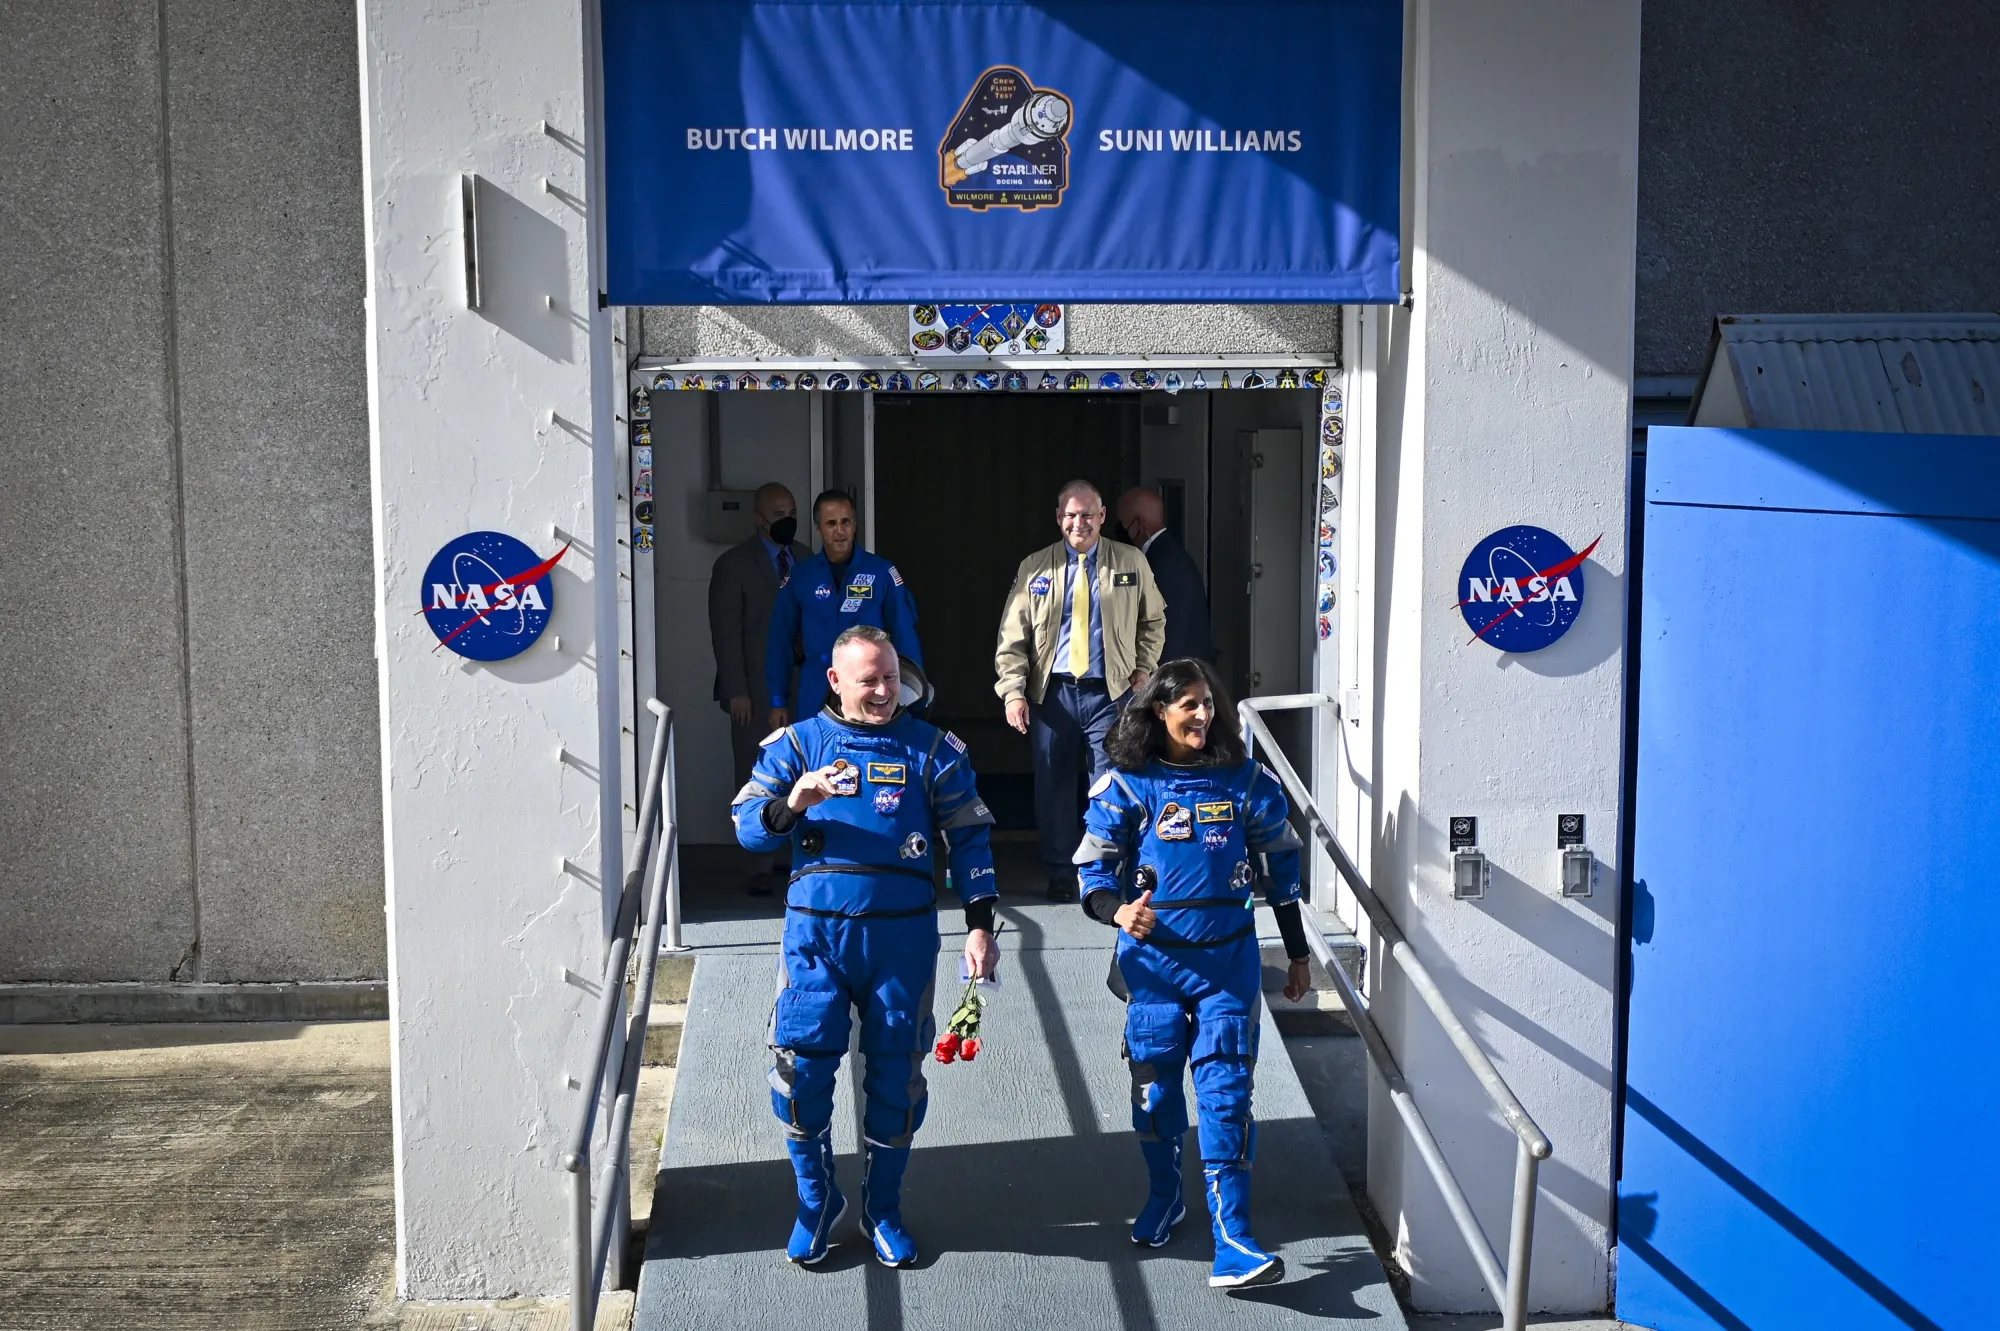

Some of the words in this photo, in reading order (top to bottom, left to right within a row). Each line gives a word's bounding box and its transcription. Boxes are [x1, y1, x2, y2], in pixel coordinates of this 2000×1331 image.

[687, 128, 777, 150] BUTCH
[783, 128, 914, 151] WILMORE
[1099, 129, 1163, 151] SUNI
[1169, 129, 1302, 152] WILLIAMS
[992, 164, 1057, 175] STARLINER
[431, 583, 547, 611] NASA
[1468, 576, 1578, 602] NASA
[875, 796, 900, 805] NASA
[1205, 835, 1228, 843] NASA
